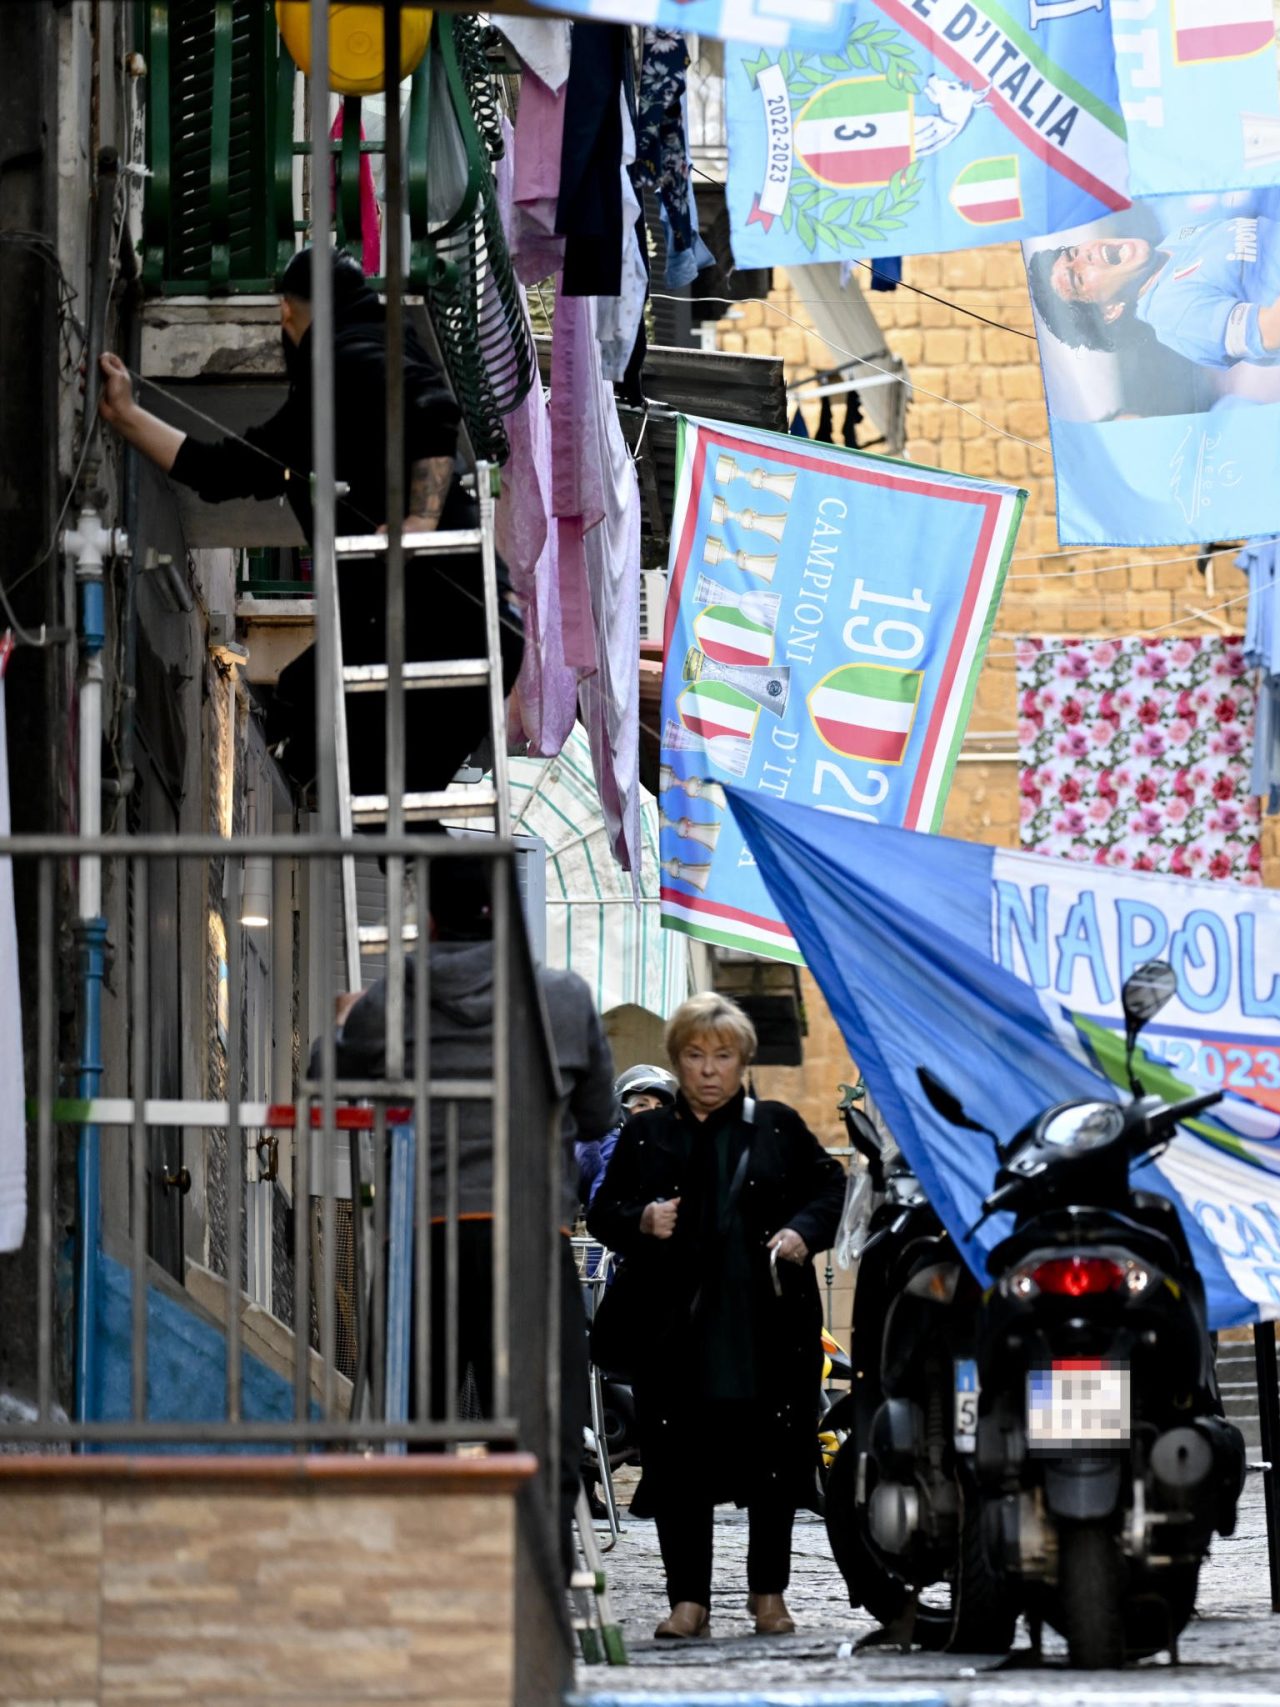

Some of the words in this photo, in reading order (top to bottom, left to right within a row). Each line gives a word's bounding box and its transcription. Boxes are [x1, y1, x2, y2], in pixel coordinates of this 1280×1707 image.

[943, 2, 1080, 147] D'ITALIA
[834, 122, 877, 141] 3
[786, 497, 848, 667] CAMPIONI
[842, 577, 931, 660] 19
[812, 759, 889, 824] 2
